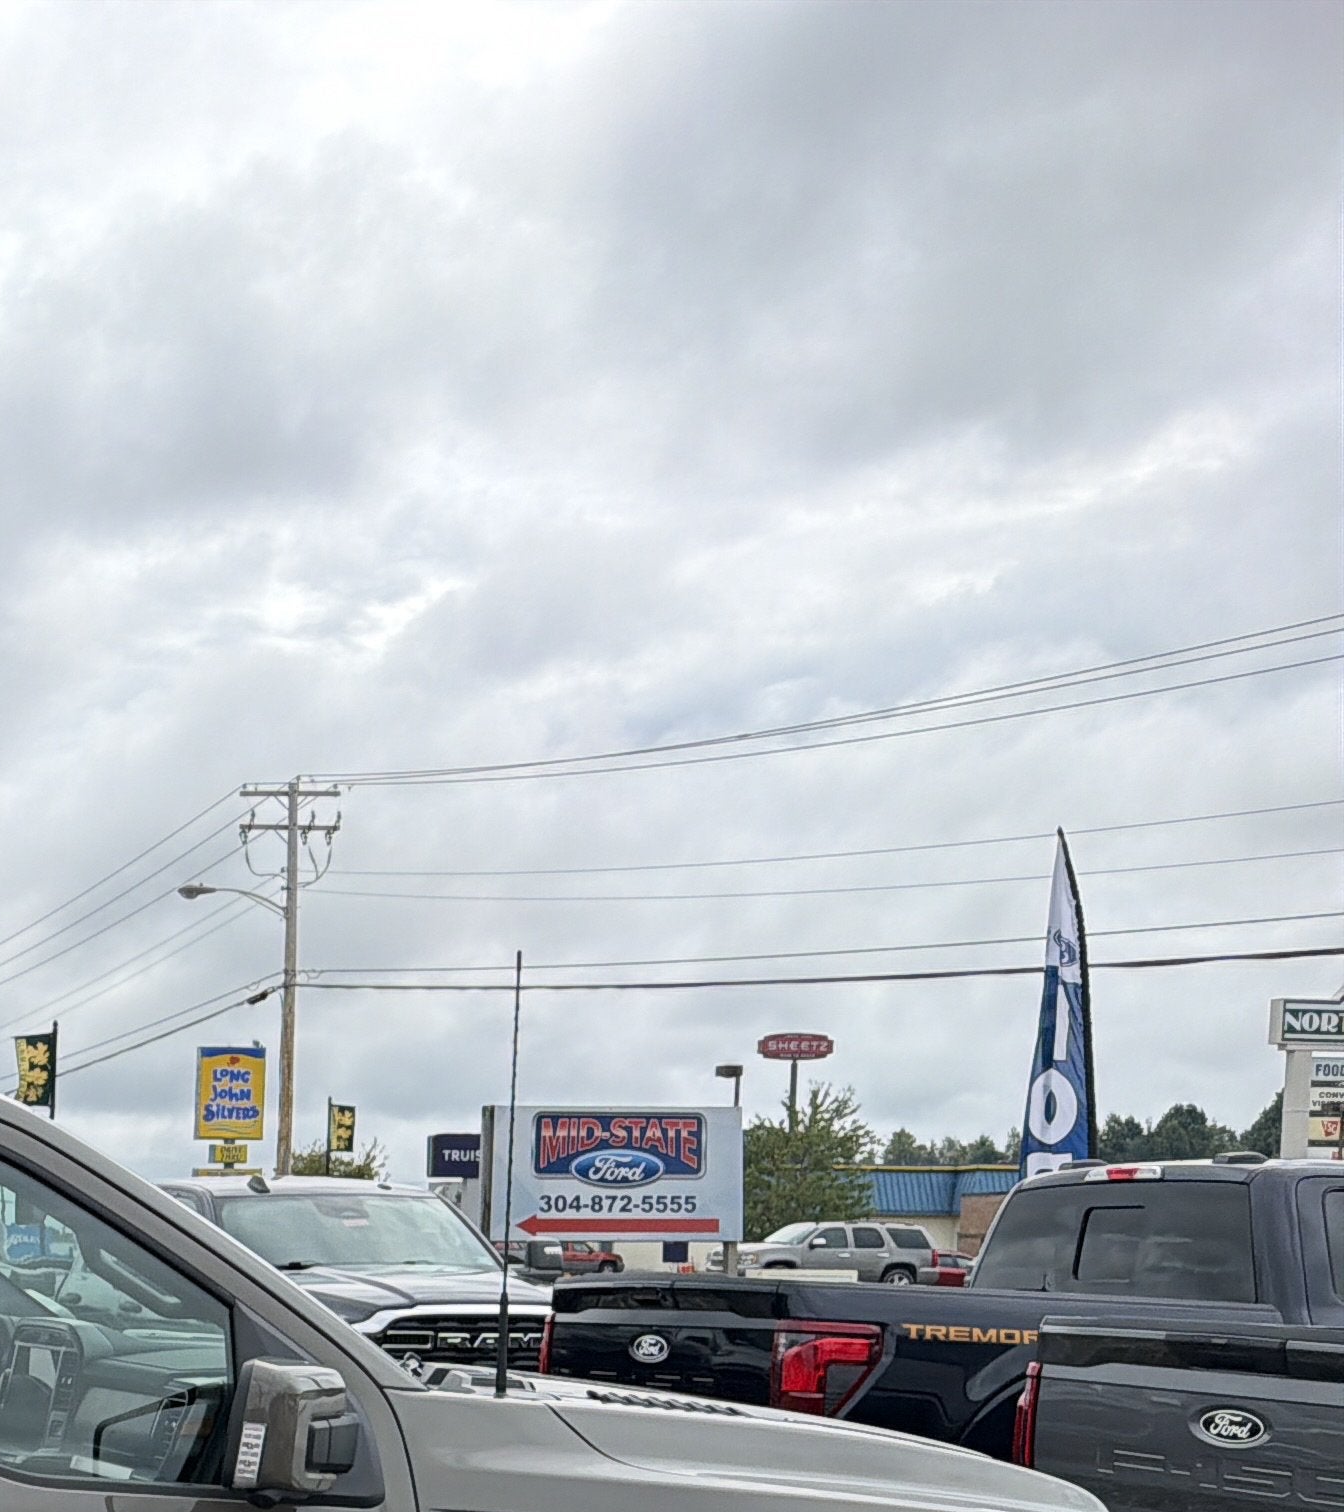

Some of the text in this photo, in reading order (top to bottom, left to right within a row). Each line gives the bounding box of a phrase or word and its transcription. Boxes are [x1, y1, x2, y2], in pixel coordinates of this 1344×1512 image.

[768, 1041, 829, 1051] SHEETZ
[212, 1068, 251, 1083] LONG
[540, 1118, 698, 1169] MID-STATE
[442, 1149, 481, 1162] TRUIS
[588, 1155, 645, 1182] Ford
[538, 1194, 697, 1213] 304-872-5555
[1209, 1412, 1253, 1440] Ford
